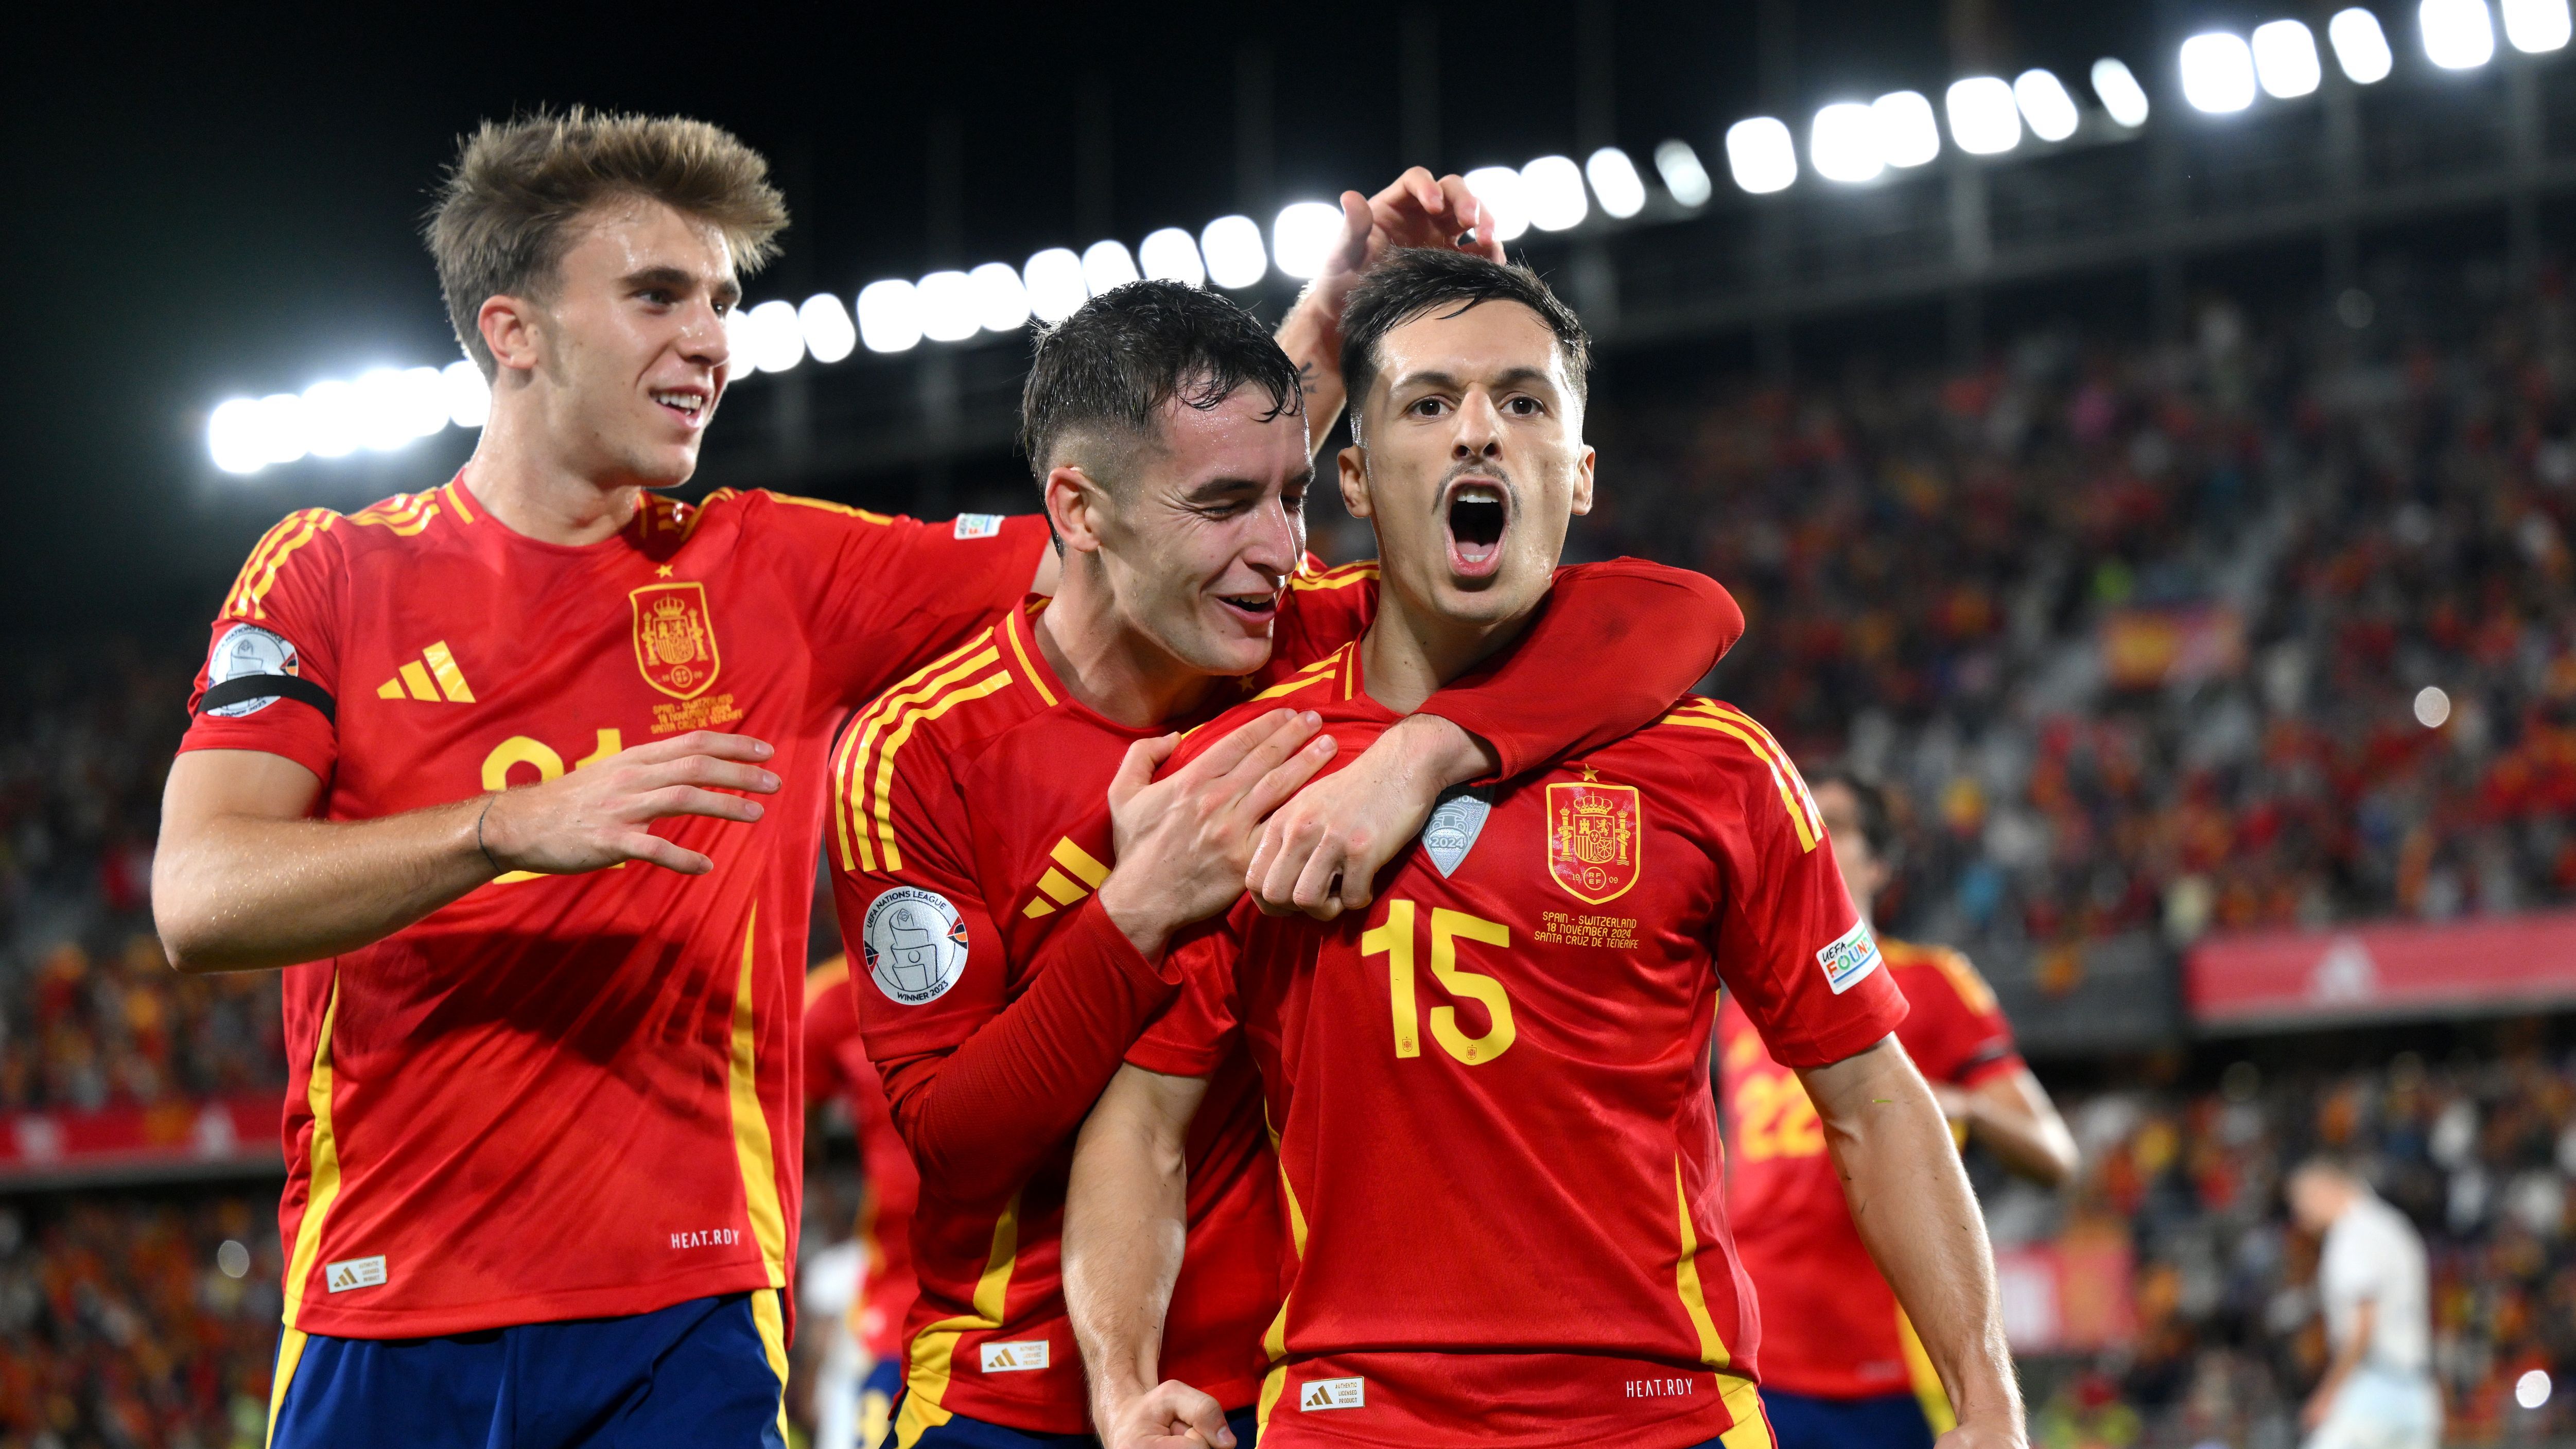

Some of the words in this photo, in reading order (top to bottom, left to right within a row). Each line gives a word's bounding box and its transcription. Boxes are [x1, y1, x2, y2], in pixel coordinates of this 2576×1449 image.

[1431, 837, 1464, 848] 2024
[1609, 876, 1618, 884] 09
[866, 910, 878, 928] UEFA
[877, 891, 911, 910] NATIONS
[913, 891, 947, 910] LEAGUE
[1542, 911, 1568, 923] SPAIN
[1578, 915, 1637, 929] SWITZERLAND
[1534, 931, 1562, 944] SANTA
[1565, 935, 1589, 946] CRUZ
[1591, 937, 1603, 947] DE
[1606, 938, 1639, 949] TENERIFE
[1546, 922, 1557, 932] 18
[1560, 923, 1608, 937] NOVEMBER
[1611, 929, 1631, 938] 2024
[1822, 941, 1847, 962] UEFA
[1826, 935, 1874, 977] FOUND
[897, 991, 929, 1001] WINNER
[930, 980, 948, 997] 2023
[1362, 899, 1516, 1066] 15
[1734, 1070, 1826, 1162] 22
[671, 1228, 739, 1249] HEAT.RDY
[1626, 1378, 1692, 1398] HEAT.RDY
